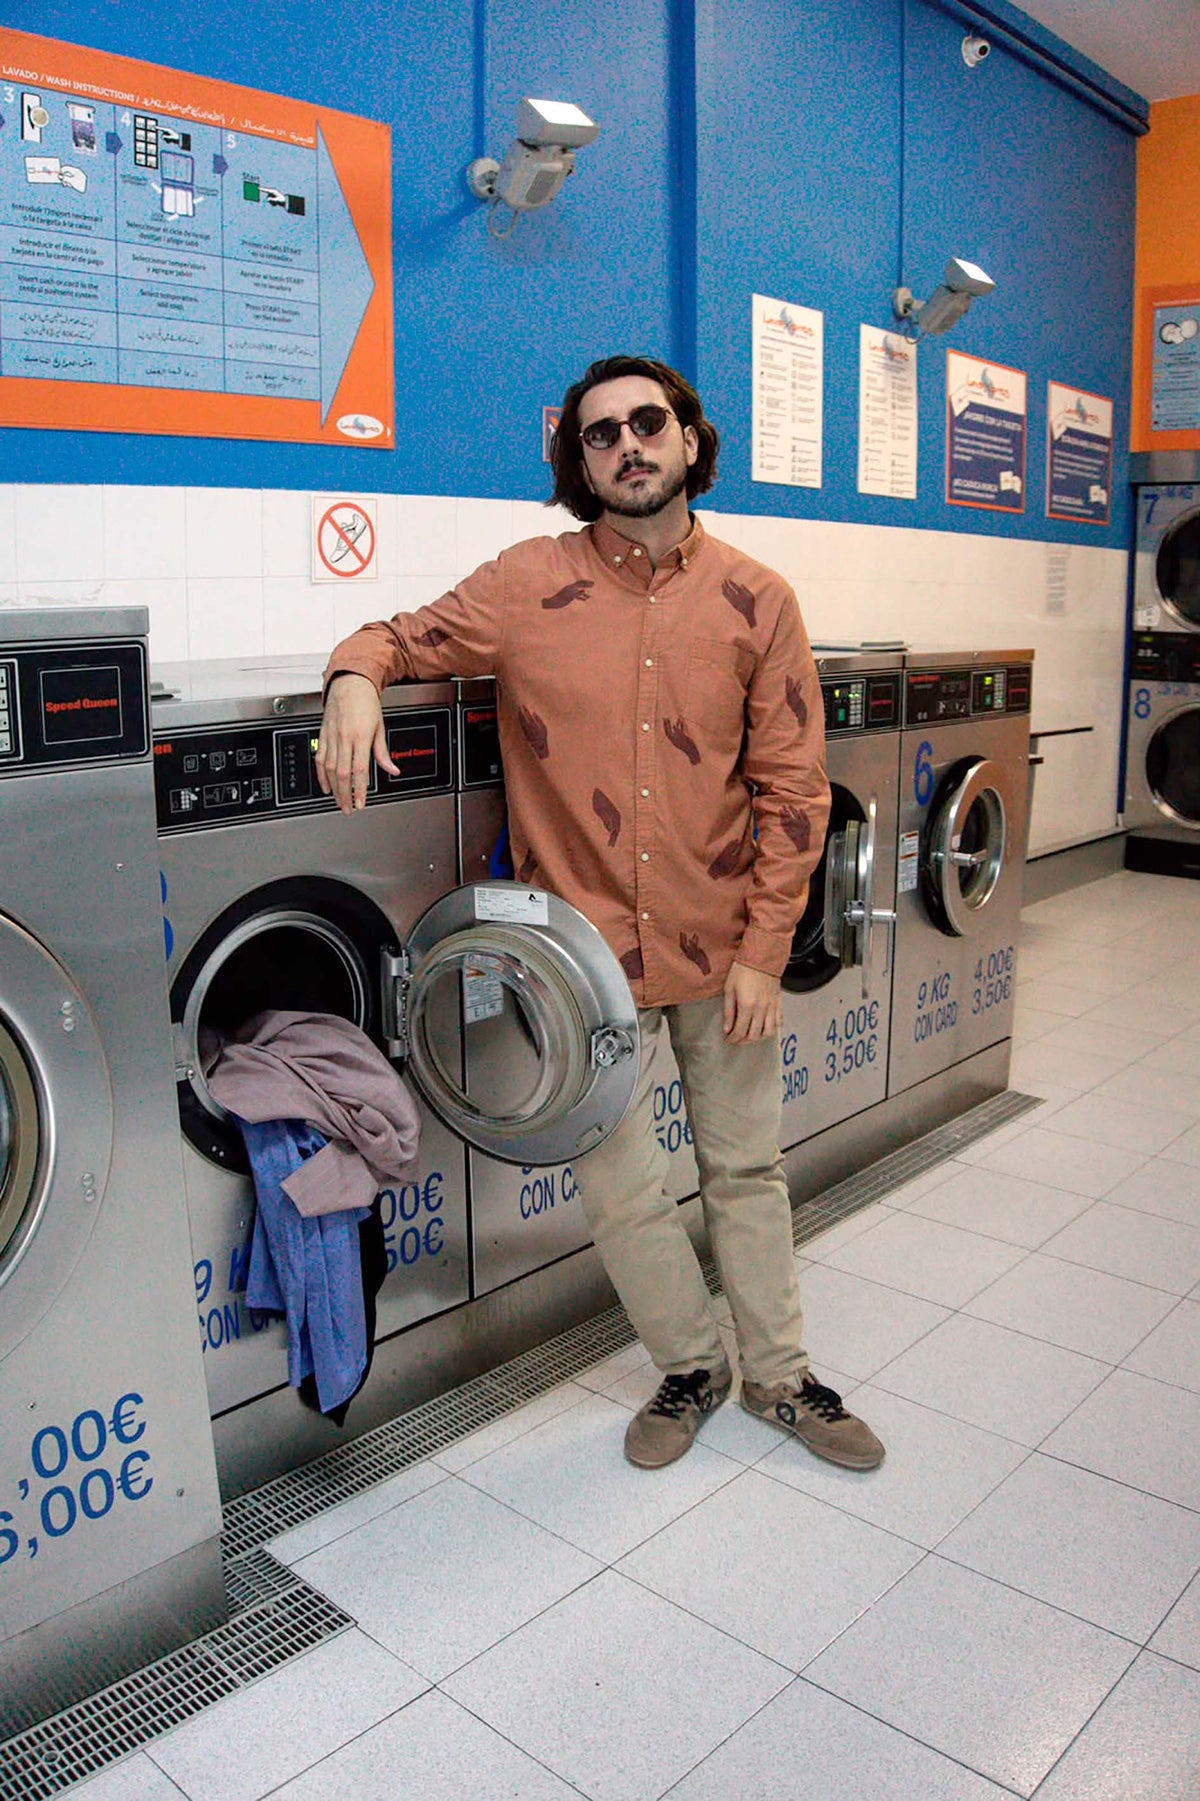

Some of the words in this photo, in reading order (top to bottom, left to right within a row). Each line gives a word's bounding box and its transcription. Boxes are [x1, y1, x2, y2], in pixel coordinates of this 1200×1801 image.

[2, 65, 39, 80] LAVADO
[46, 75, 72, 88] WASH
[73, 81, 136, 102] INSTRUCTIONS
[2, 86, 14, 104] 3
[120, 111, 132, 128] 4
[226, 134, 236, 150] 5
[1143, 494, 1159, 524] 7
[45, 700, 81, 714] Speed
[82, 698, 118, 710] Queen
[1134, 688, 1152, 719] 8
[391, 749, 412, 760] Speed
[914, 740, 934, 807] 6
[974, 946, 1014, 986] 4,00€
[916, 982, 927, 1010] 9
[930, 972, 951, 1004] KG
[972, 974, 1012, 1016] 3,50€
[826, 1000, 880, 1048] 4,00€
[914, 1011, 934, 1043] CON
[935, 1000, 958, 1034] CARD
[780, 1033, 798, 1067] G
[824, 1033, 878, 1085] 3,50€
[379, 1172, 443, 1230] 00€
[520, 1173, 554, 1220] CON
[384, 1217, 444, 1275] 50€
[194, 1259, 212, 1304] 9
[228, 1243, 250, 1292] K
[18, 1392, 146, 1500] ,00€
